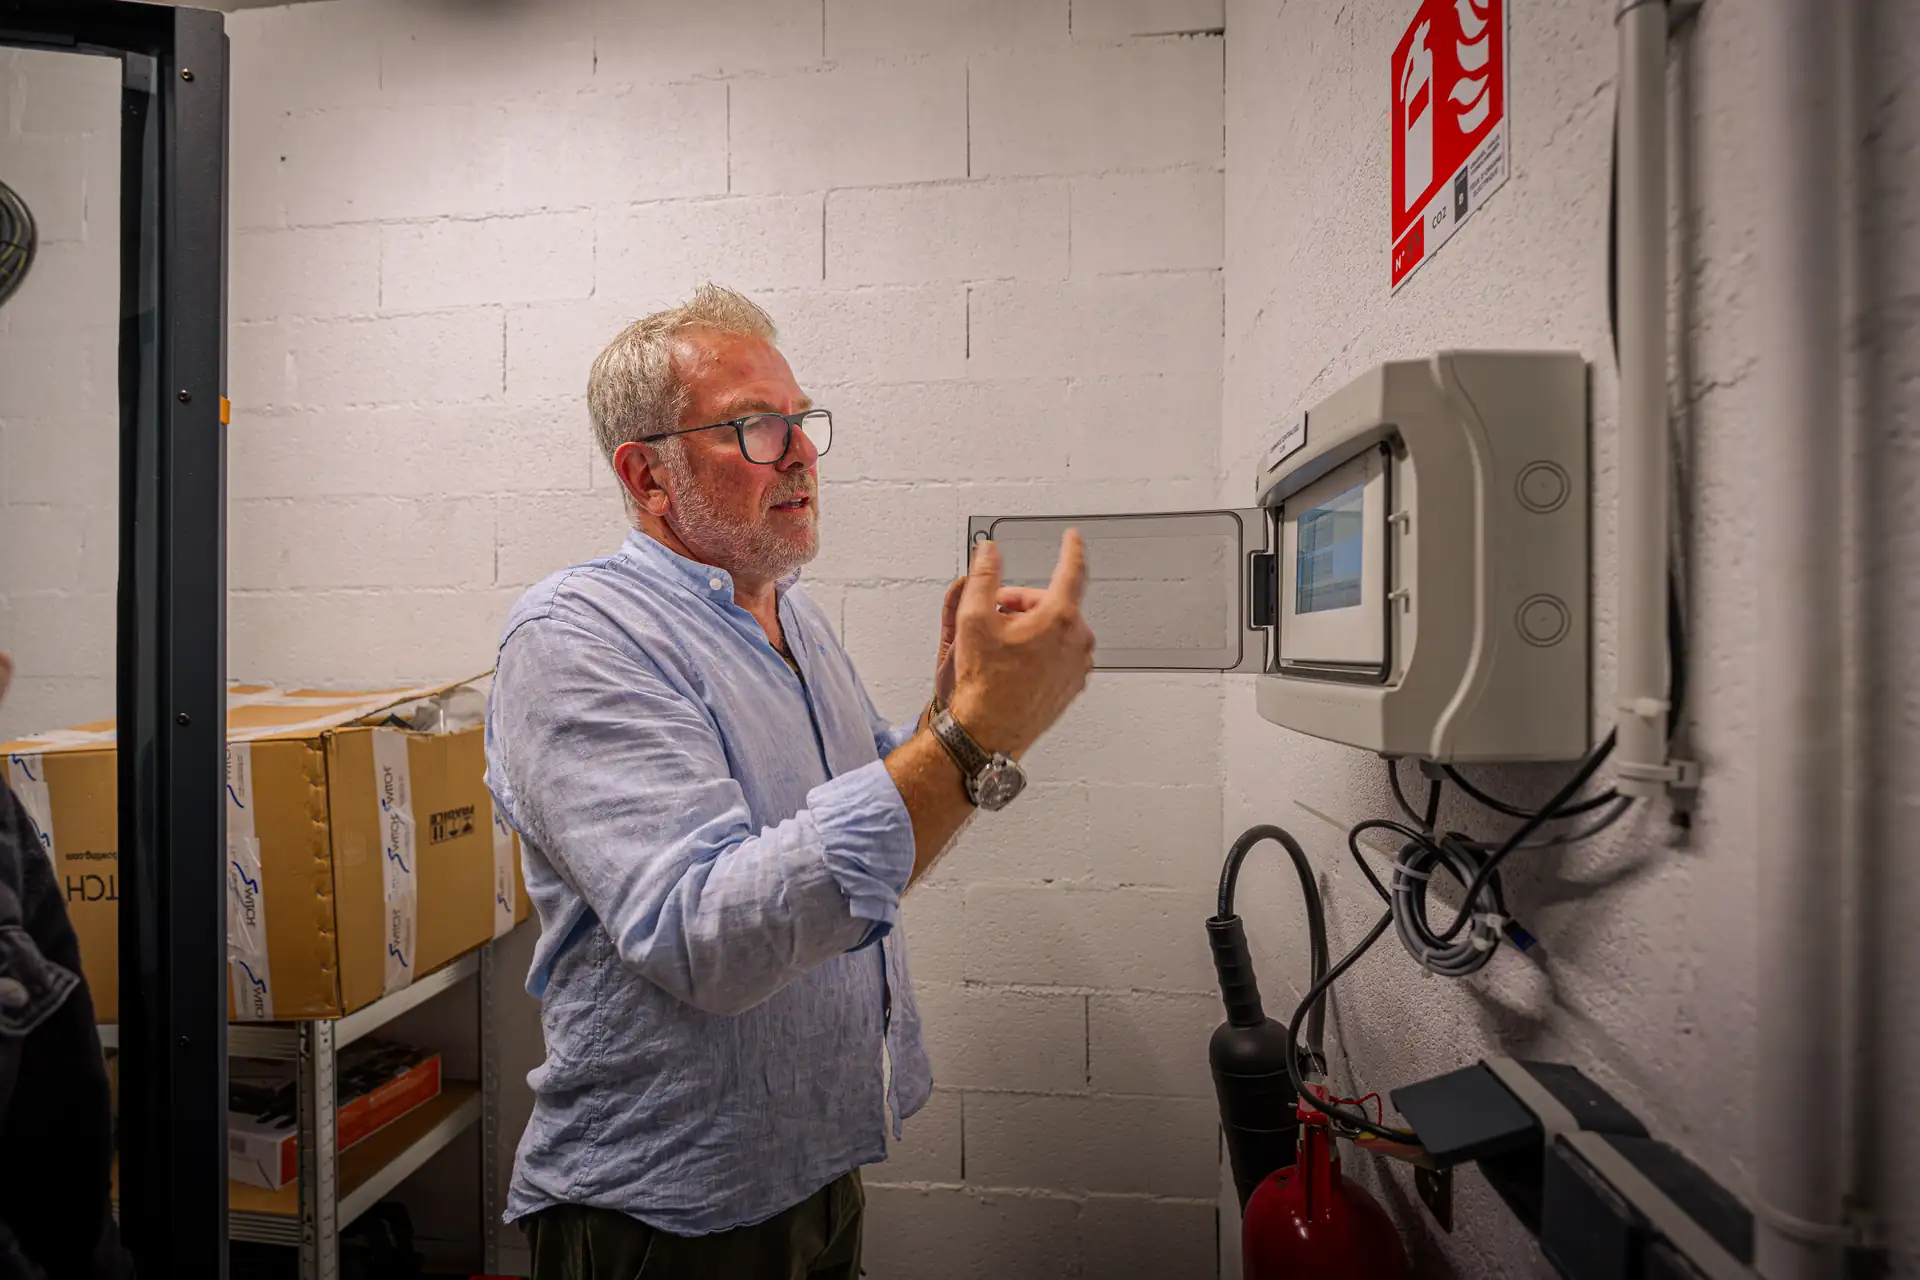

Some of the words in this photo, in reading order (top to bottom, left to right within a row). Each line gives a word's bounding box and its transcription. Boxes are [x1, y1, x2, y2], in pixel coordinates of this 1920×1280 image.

[1432, 206, 1447, 229] CO2
[1395, 250, 1405, 273] N°
[66, 875, 118, 902] TCH
[231, 861, 258, 927] SWITCH
[239, 960, 266, 1020] SWITC
